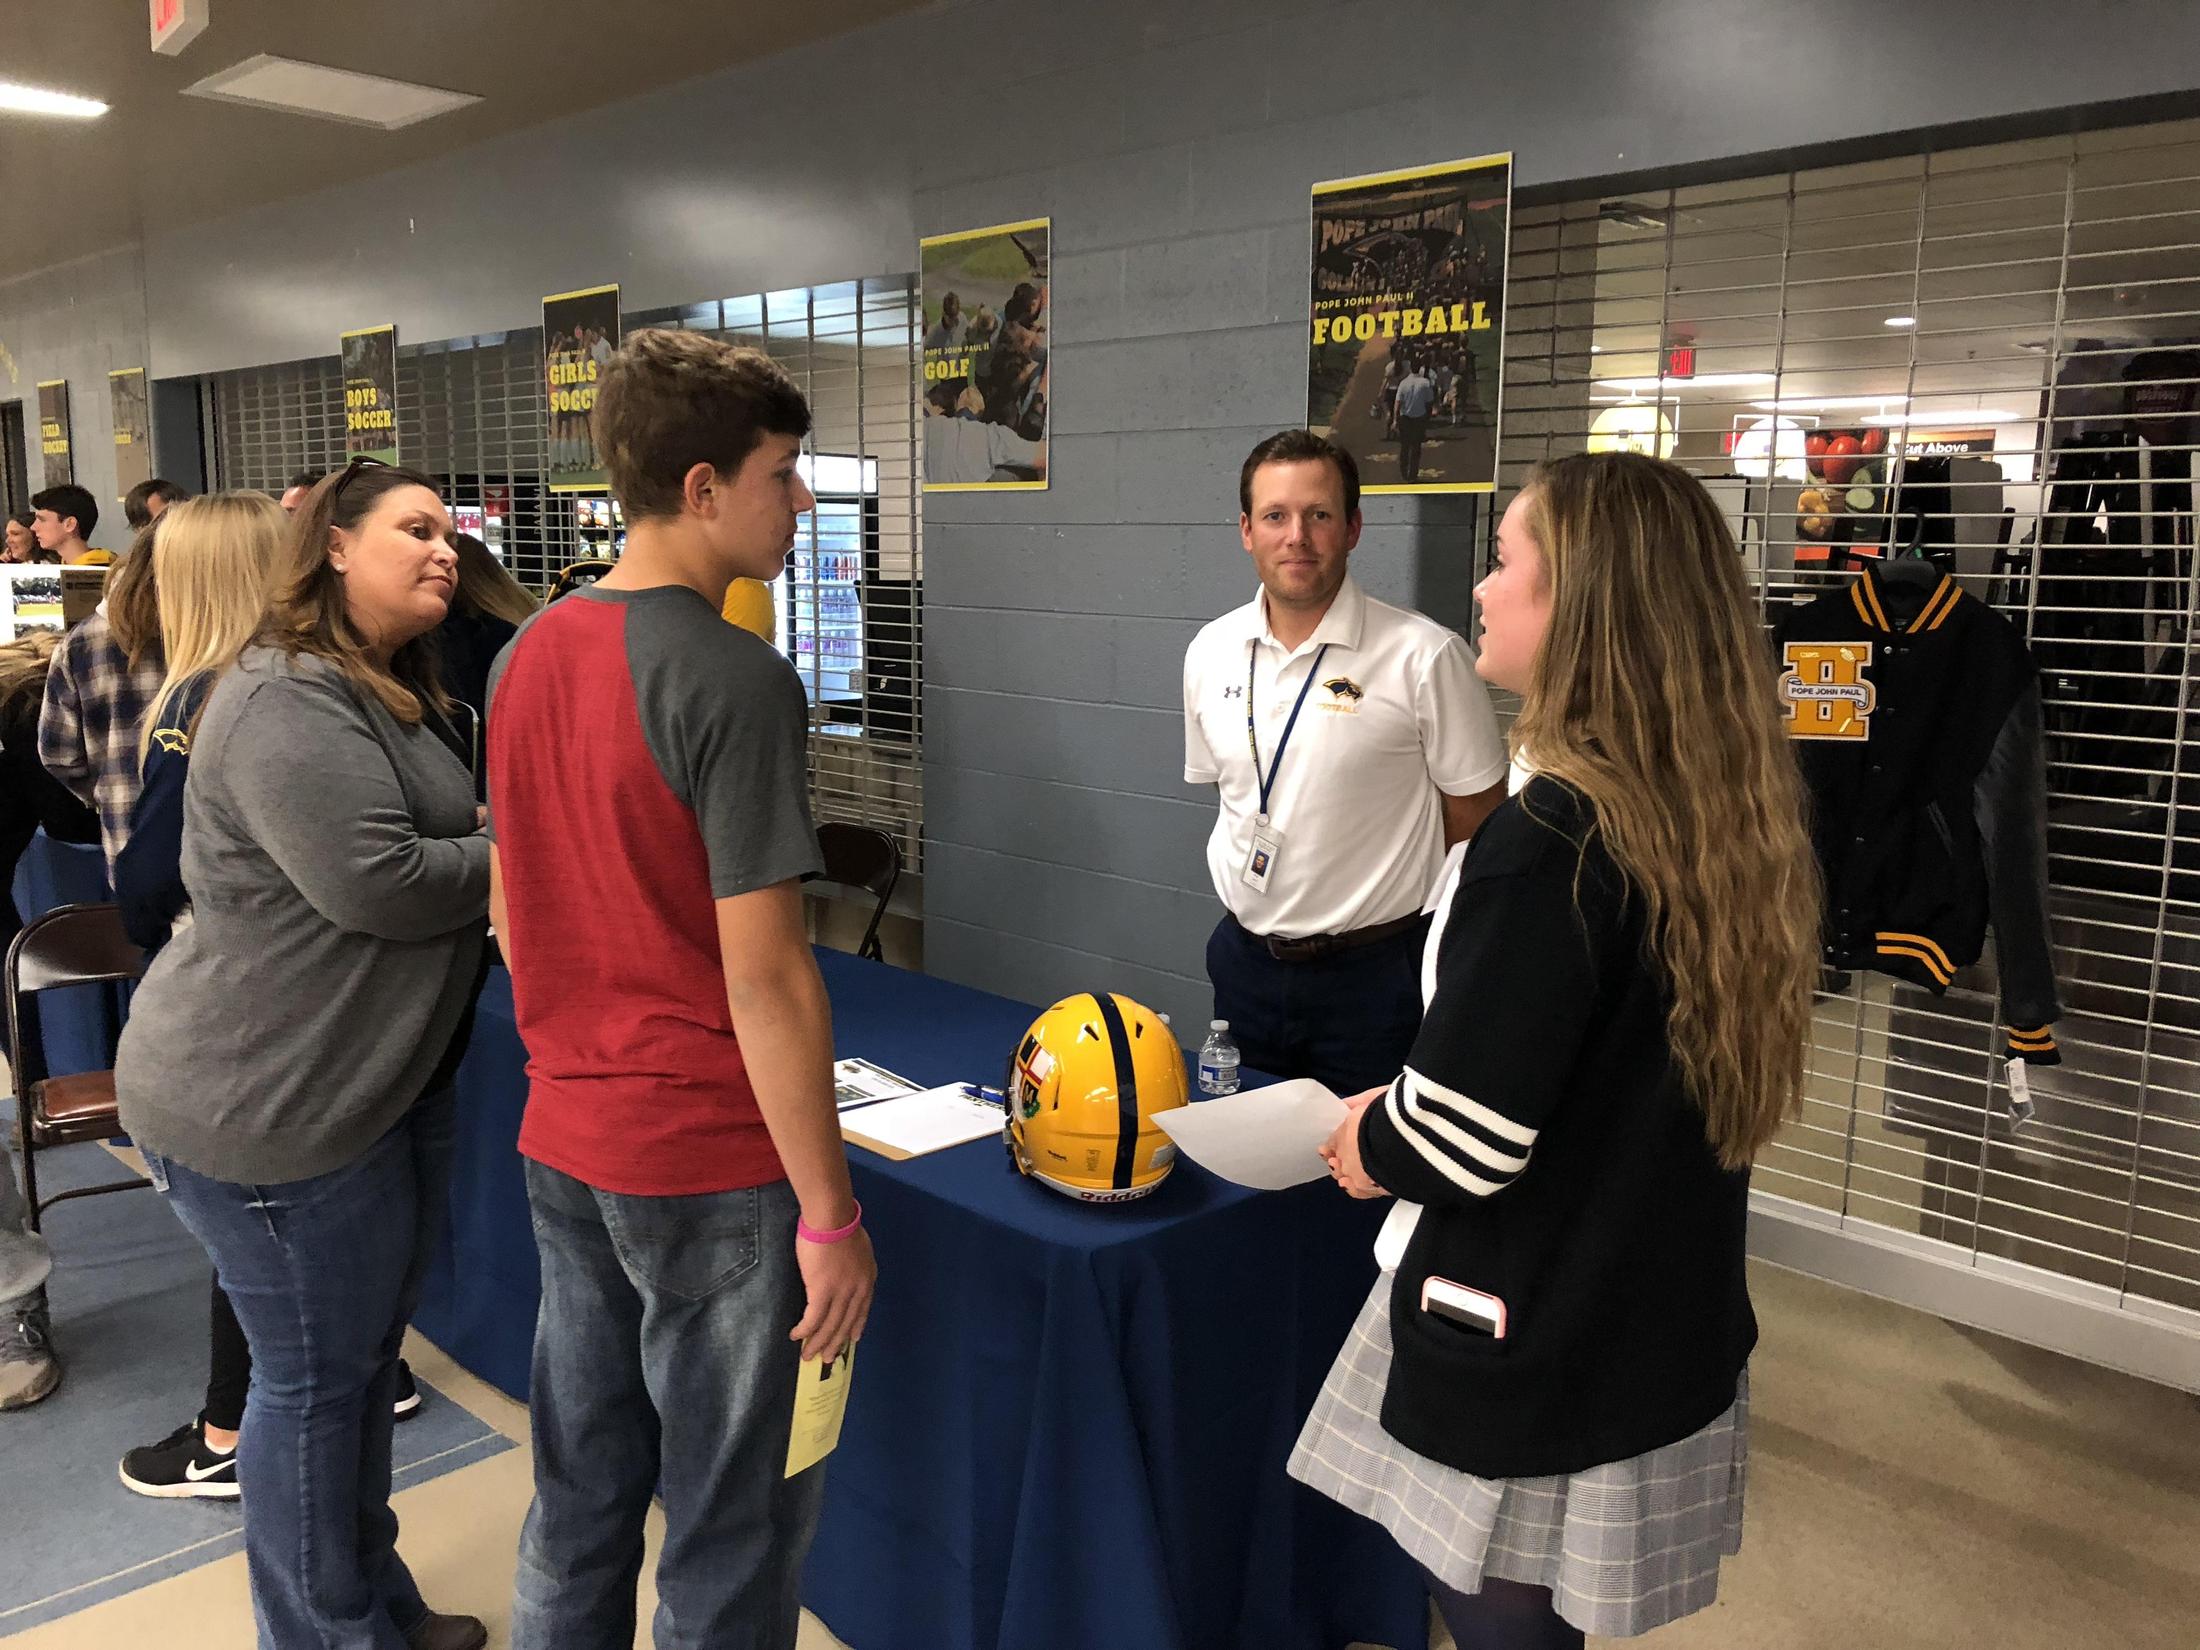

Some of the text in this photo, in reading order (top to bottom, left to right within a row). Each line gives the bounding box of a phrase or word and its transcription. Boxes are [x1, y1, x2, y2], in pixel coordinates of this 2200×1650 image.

[1315, 292, 1414, 310] POPE JOHN PAUL II
[1313, 301, 1491, 345] FOOTBALL
[549, 359, 597, 385] GIRLS
[924, 357, 970, 380] GOLF
[346, 387, 377, 407] BOYS
[550, 387, 600, 412] SOCC
[348, 409, 392, 431] SOCCER
[1925, 442, 1969, 454] Above
[1791, 687, 1862, 697] POPE JOHN PAUL
